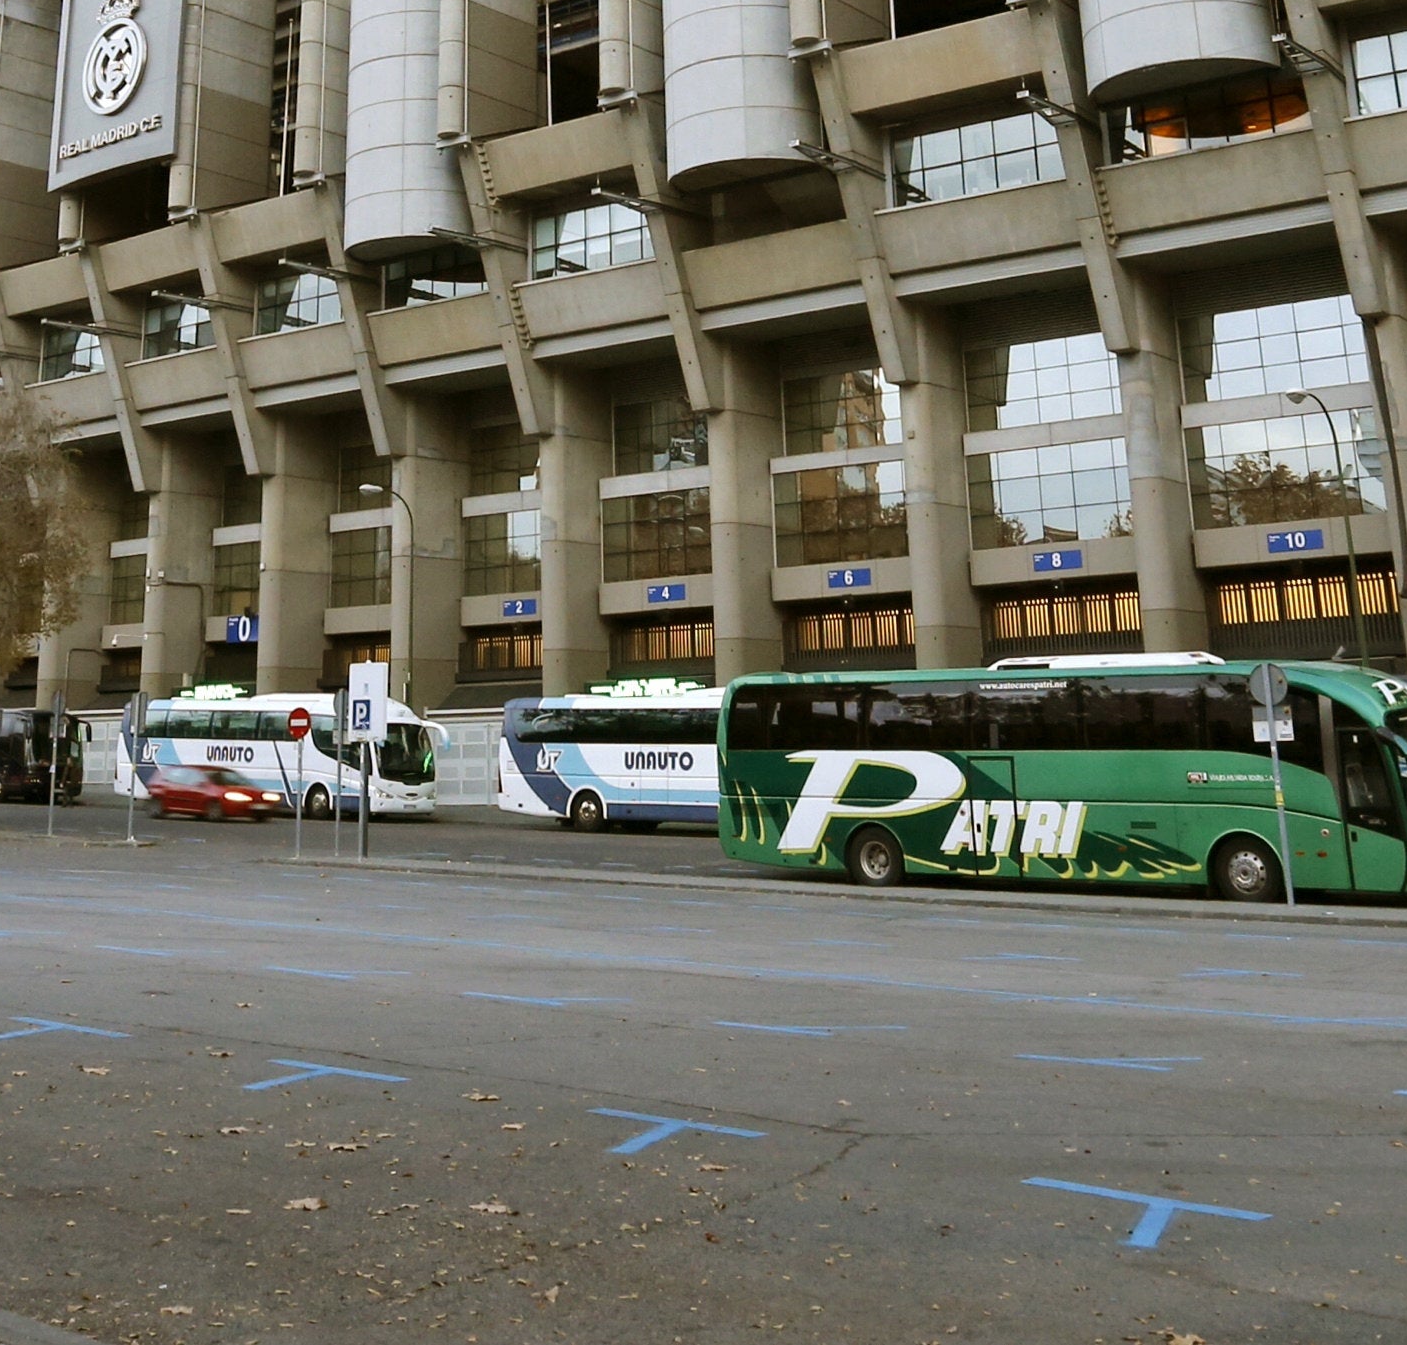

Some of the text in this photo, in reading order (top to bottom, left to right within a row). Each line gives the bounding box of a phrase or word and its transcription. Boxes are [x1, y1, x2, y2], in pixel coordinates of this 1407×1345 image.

[59, 138, 90, 159] REAL
[91, 121, 139, 148] MADRID
[1285, 532, 1306, 549] 10
[1051, 552, 1062, 568] 8
[844, 570, 854, 586] 6
[661, 586, 670, 600] 4
[516, 601, 523, 614] 2
[238, 616, 251, 642] 0
[979, 680, 1067, 690] www.autocarespatri.net
[355, 702, 367, 727] P
[207, 745, 254, 763] UNAUTO
[625, 751, 694, 771] UNAUTO
